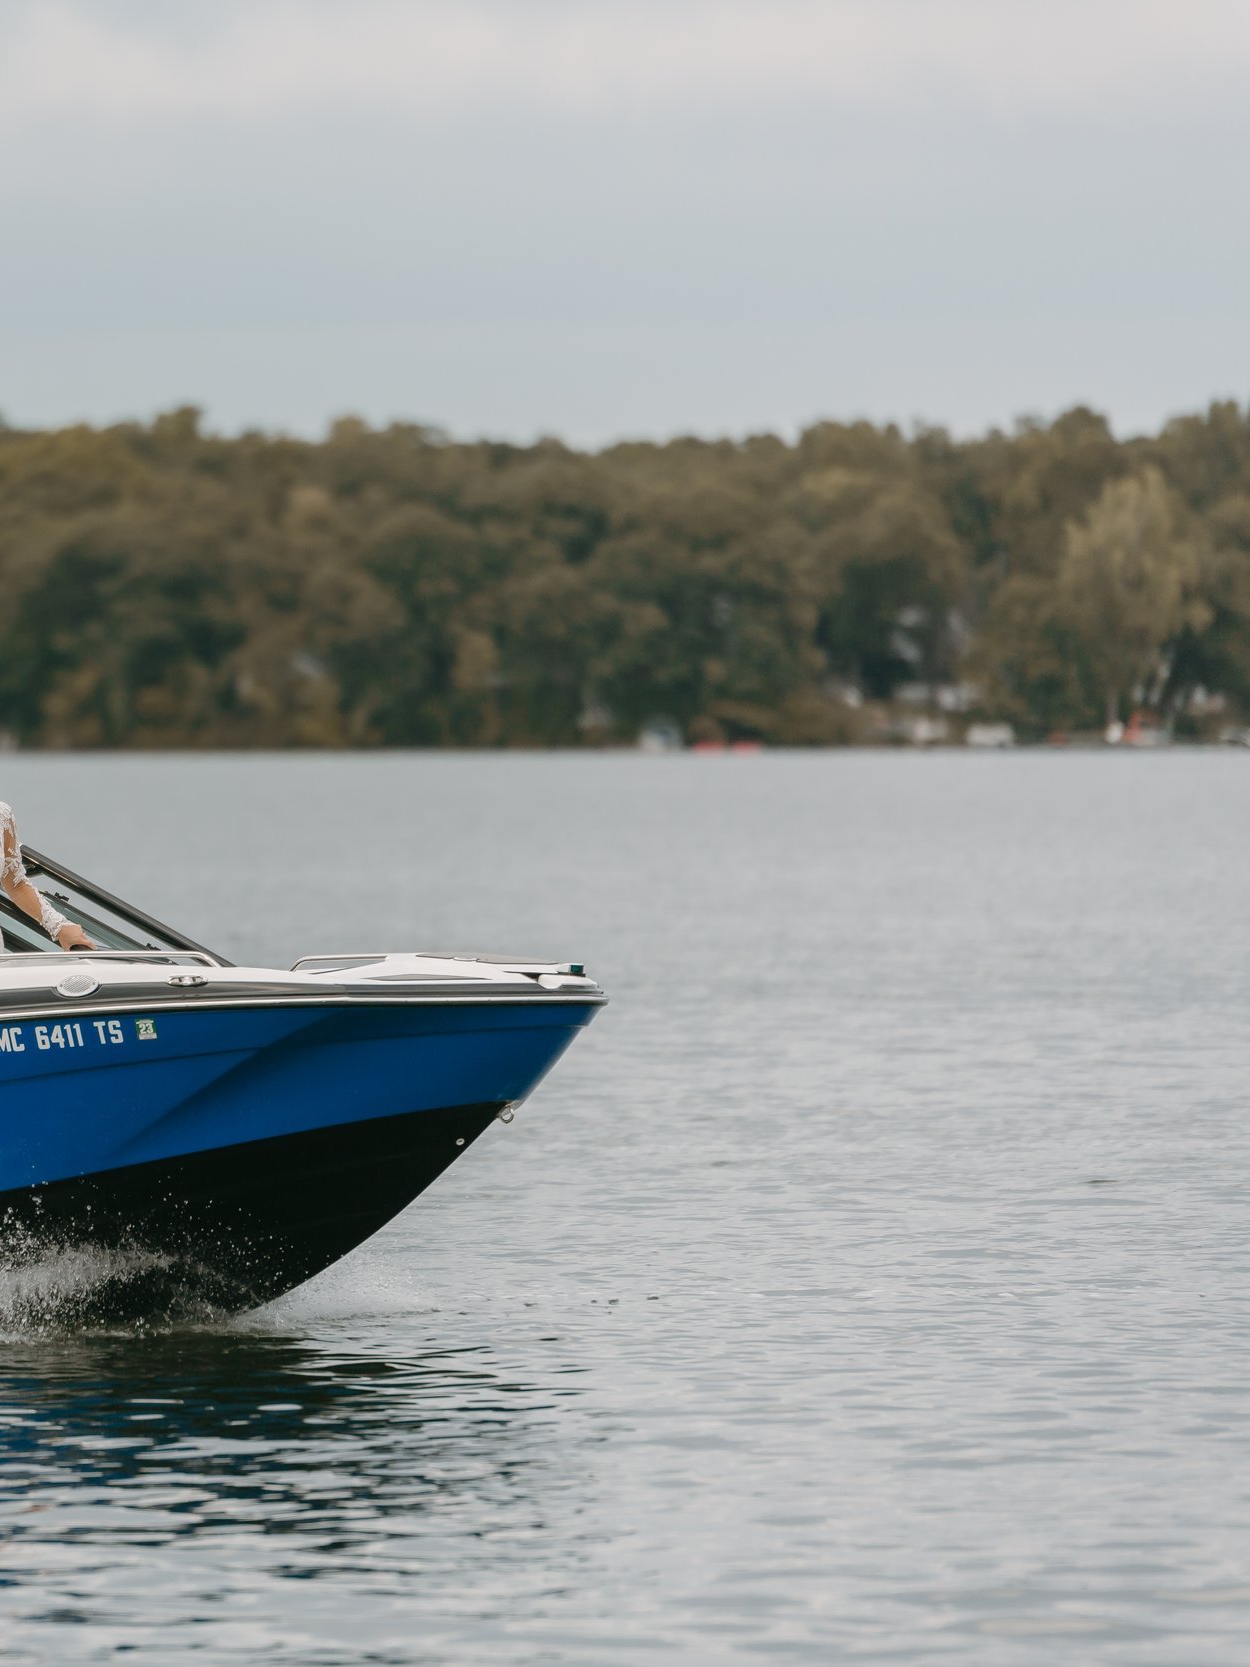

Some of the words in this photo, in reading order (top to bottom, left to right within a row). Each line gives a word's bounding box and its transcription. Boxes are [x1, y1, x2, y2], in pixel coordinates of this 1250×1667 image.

[34, 1023, 84, 1050] 6411
[93, 1020, 124, 1044] TS
[139, 1023, 154, 1034] 23
